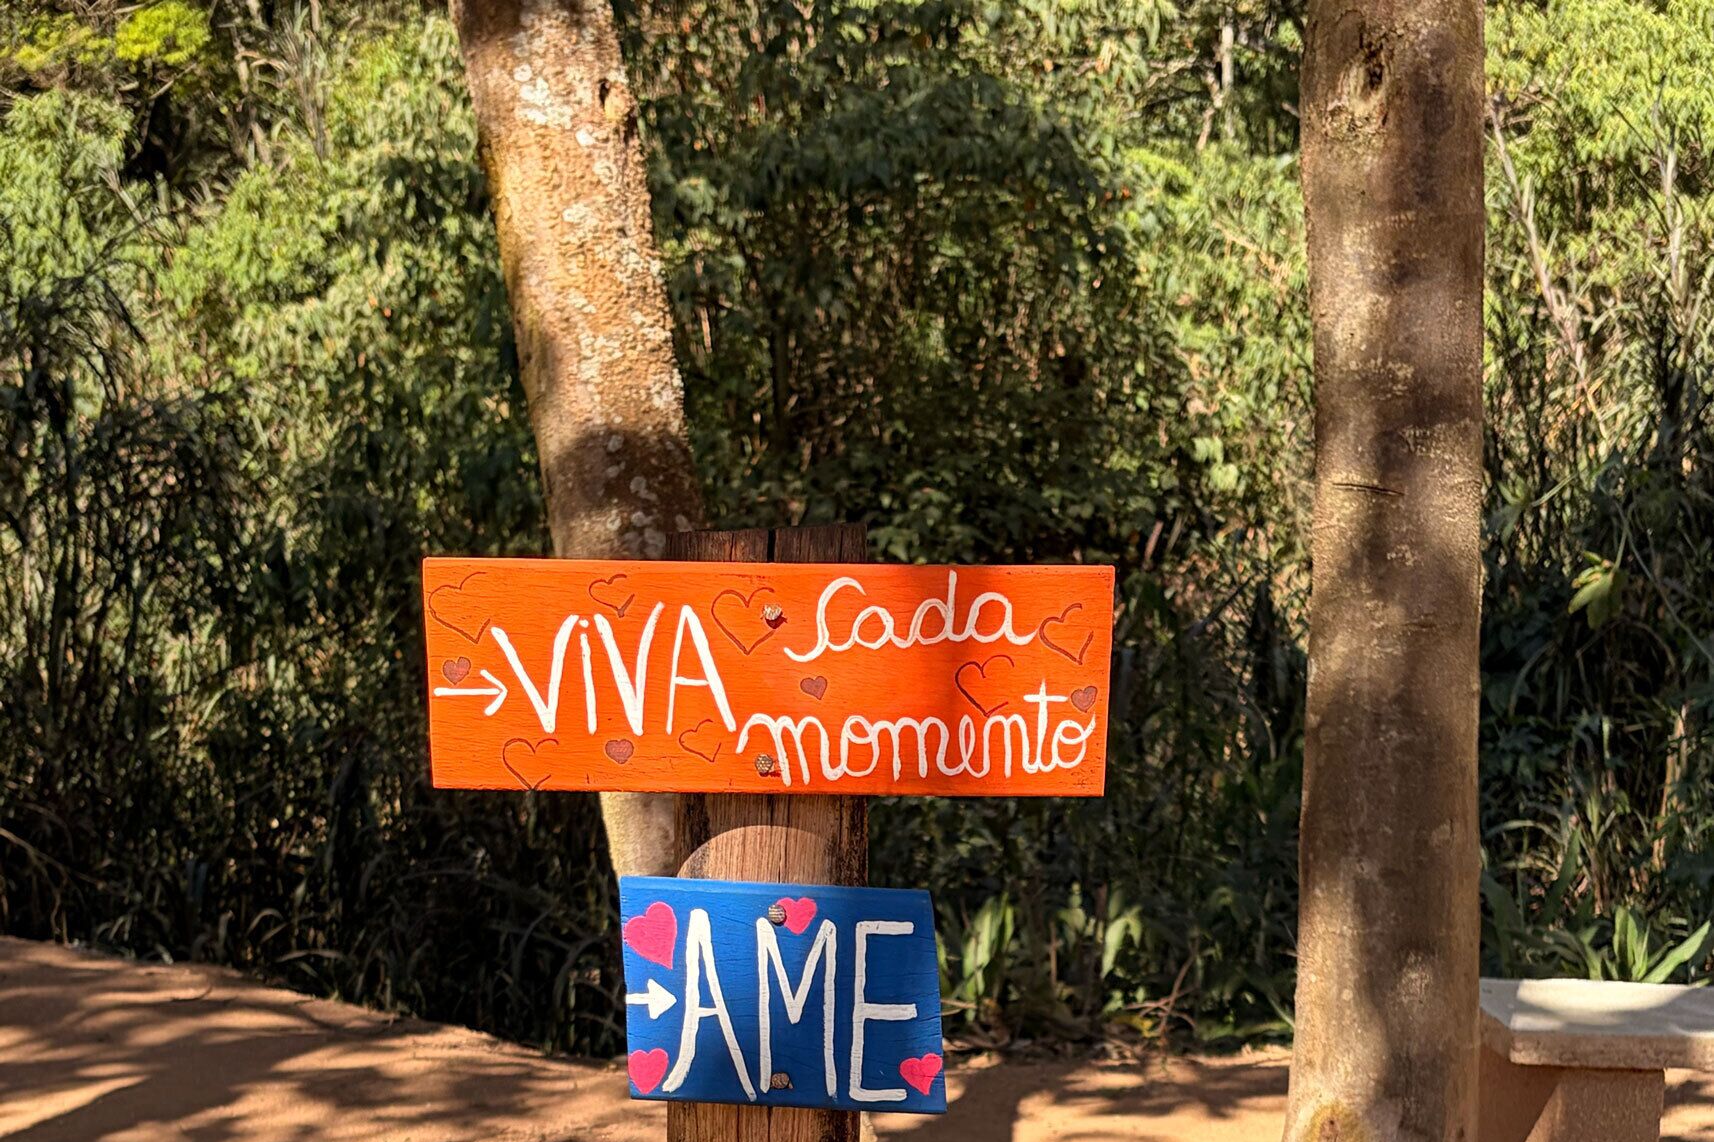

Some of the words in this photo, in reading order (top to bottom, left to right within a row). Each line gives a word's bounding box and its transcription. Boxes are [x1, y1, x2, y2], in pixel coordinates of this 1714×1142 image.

[784, 570, 1041, 664] Cada
[735, 678, 1097, 787] momento
[661, 907, 918, 1102] AME
